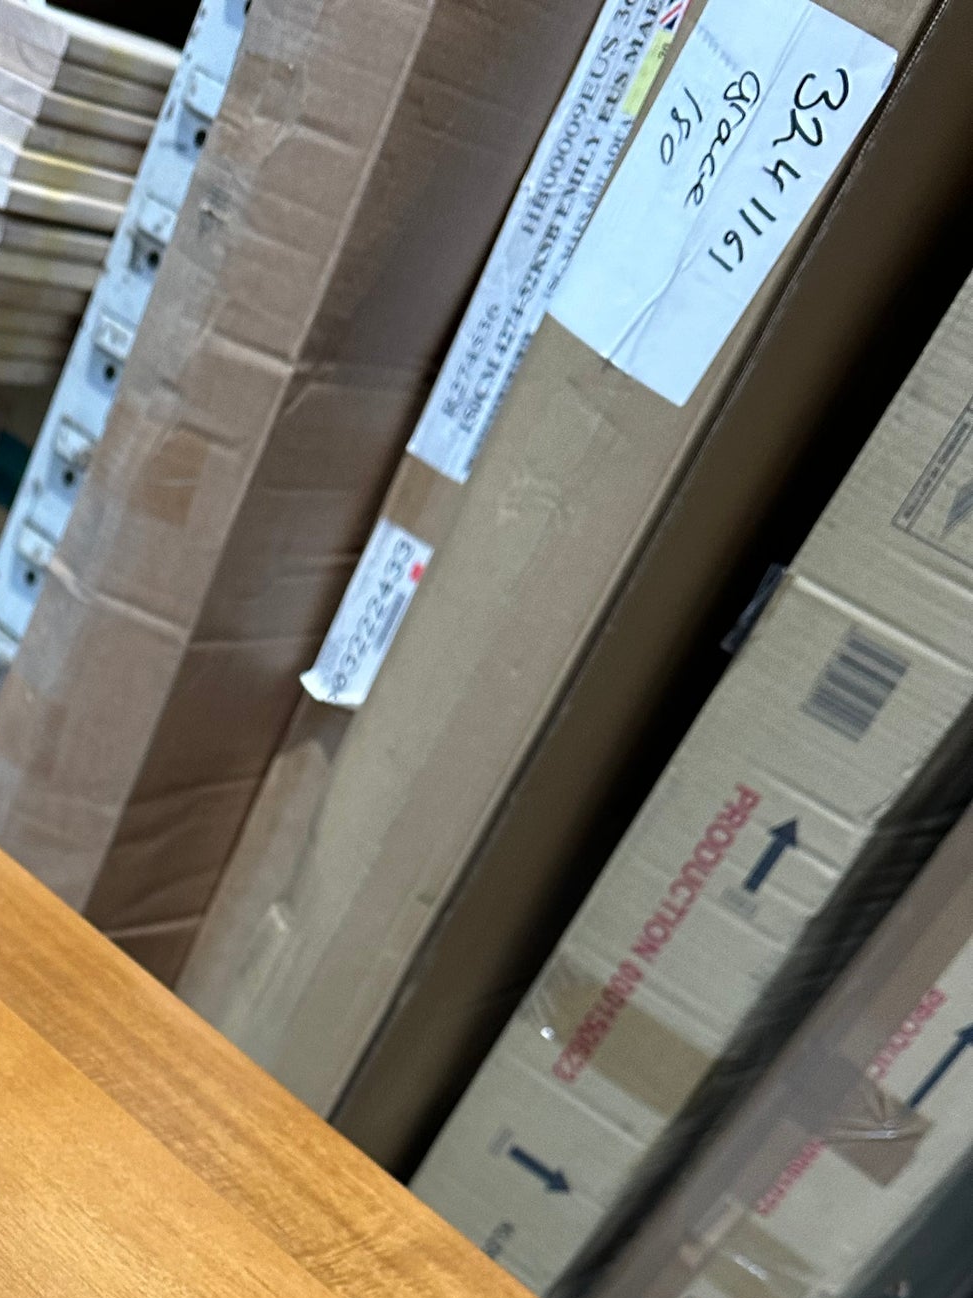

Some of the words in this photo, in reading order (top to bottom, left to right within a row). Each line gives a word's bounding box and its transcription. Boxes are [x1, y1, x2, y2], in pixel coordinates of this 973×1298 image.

[554, 131, 600, 218] EMILY
[597, 70, 630, 123] EUS
[708, 67, 850, 273] 3241161
[630, 783, 763, 964] PRODUCTION
